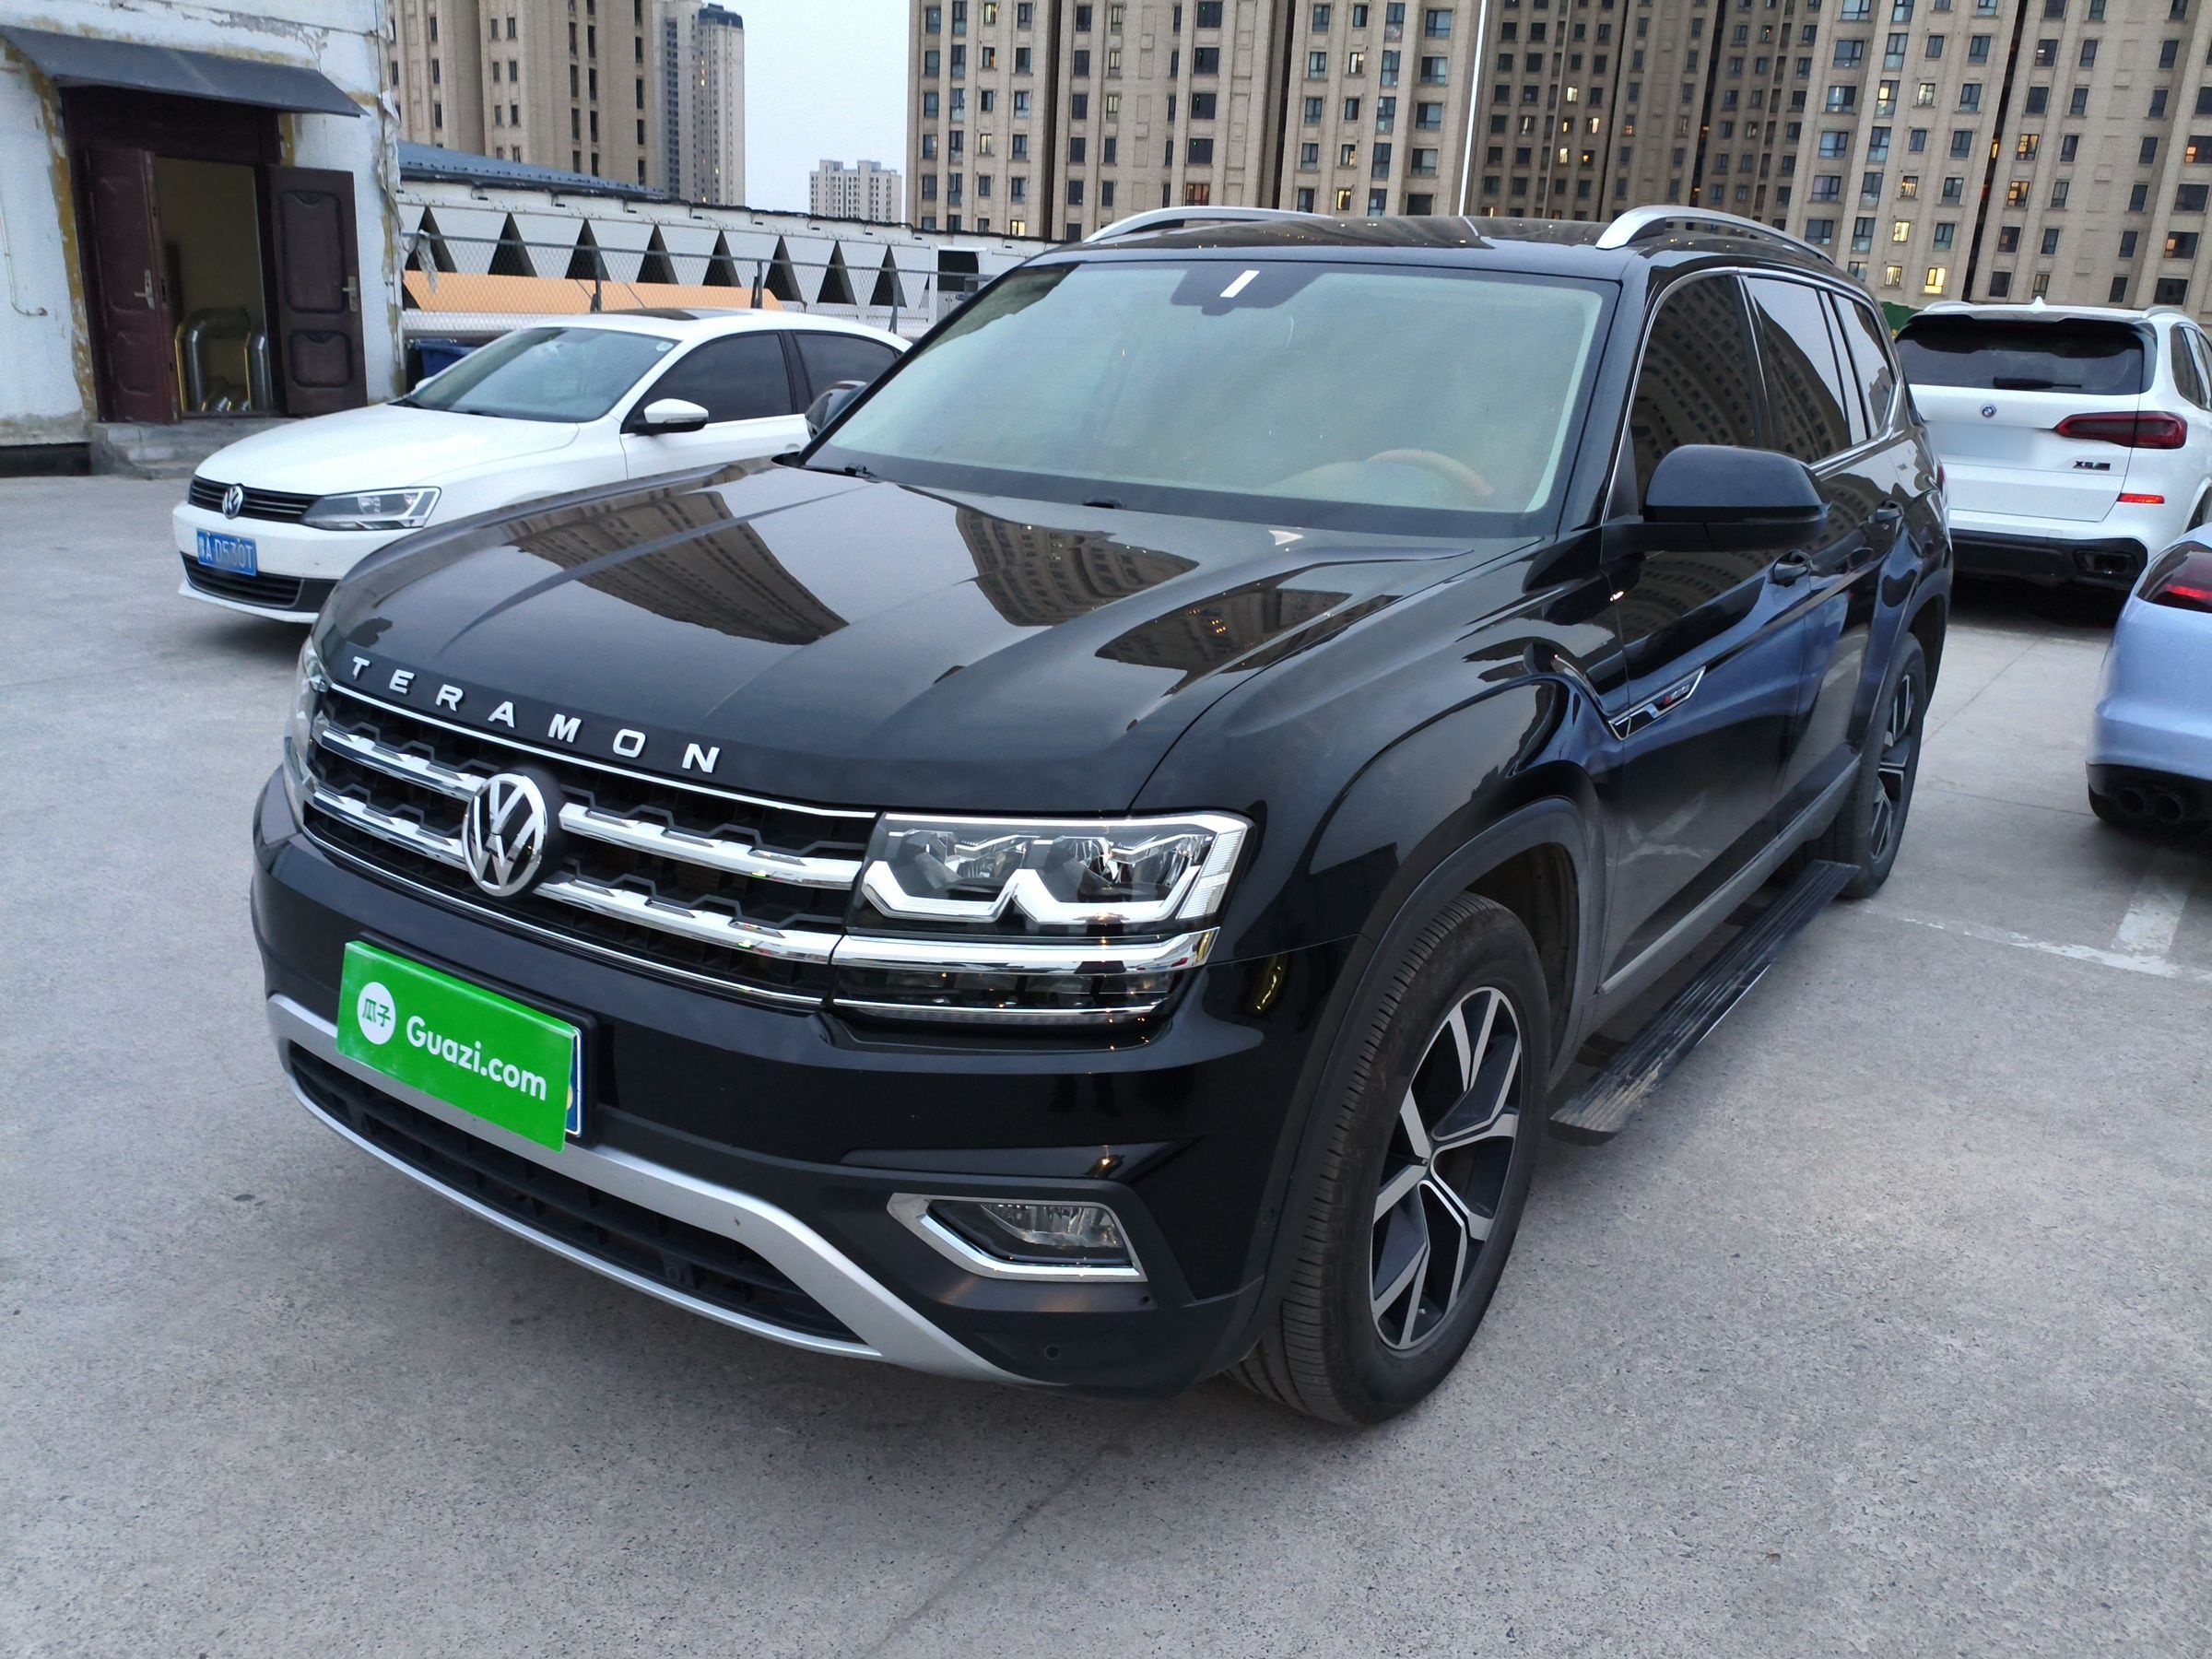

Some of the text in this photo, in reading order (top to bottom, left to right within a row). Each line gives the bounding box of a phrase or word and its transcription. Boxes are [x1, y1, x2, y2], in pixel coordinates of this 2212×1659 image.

[352, 656, 721, 773] TERAMON
[361, 997, 391, 1028] 瓜子
[406, 1016, 547, 1101] Guazi.com
